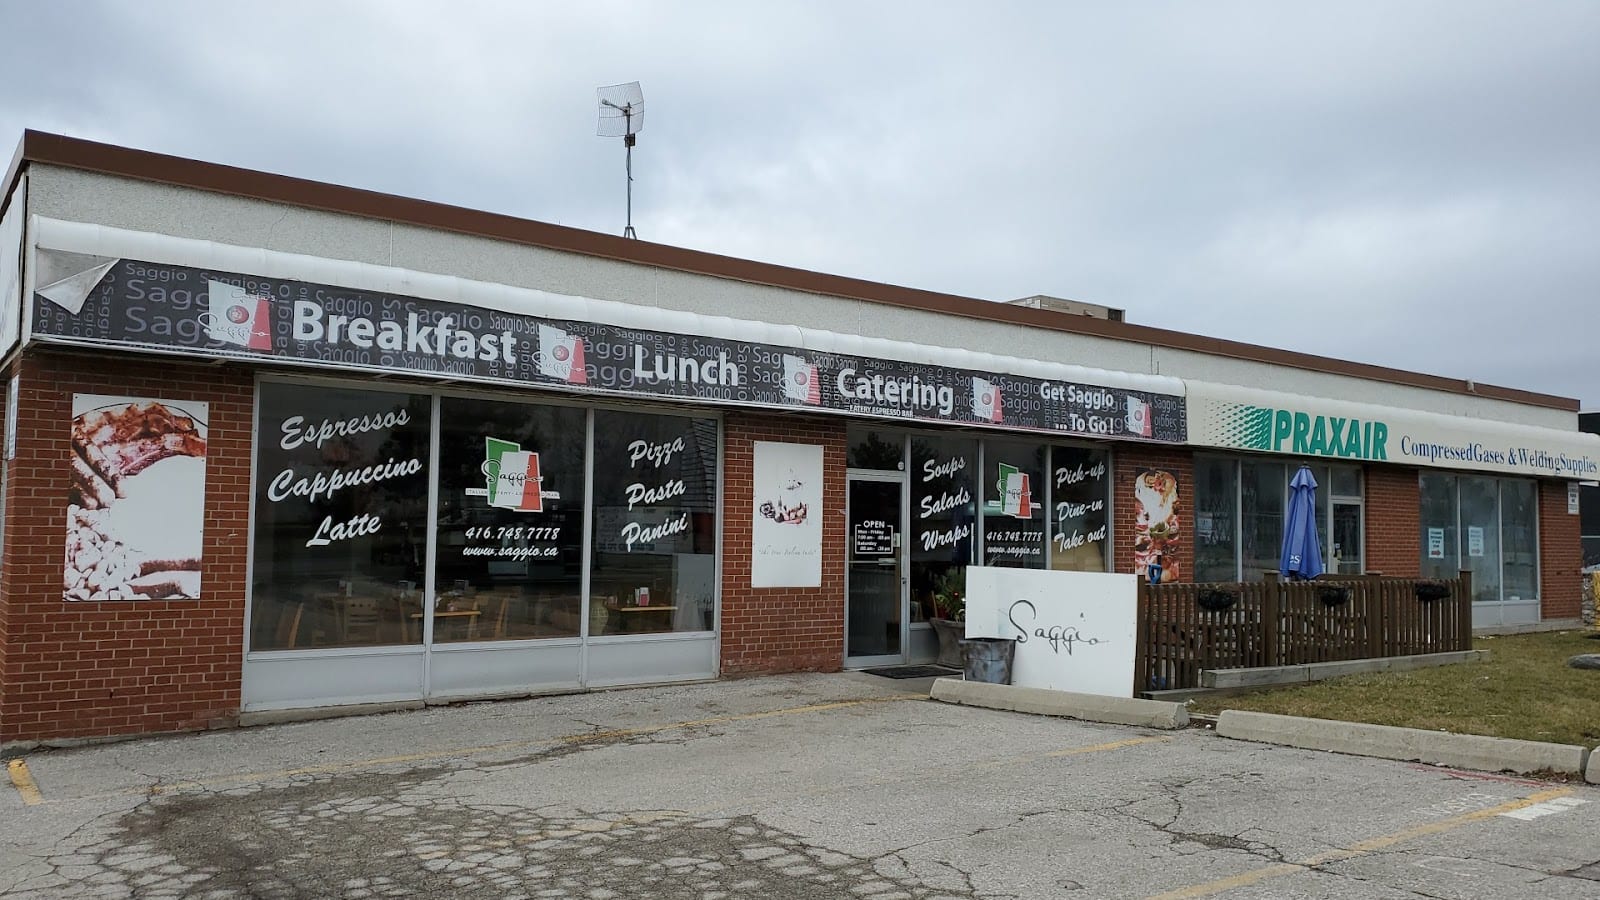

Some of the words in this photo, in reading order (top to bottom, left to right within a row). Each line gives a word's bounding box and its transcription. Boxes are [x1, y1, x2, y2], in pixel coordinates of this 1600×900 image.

[126, 262, 187, 282] Saggio
[125, 279, 209, 314] Sagg
[315, 289, 374, 320] Saggio
[97, 285, 114, 339] Saggi
[489, 311, 523, 333] Saggio
[292, 300, 517, 364] Breakfast
[565, 321, 608, 337] Saggio
[613, 327, 655, 342] Saggio
[312, 341, 371, 364] Saggio
[519, 340, 534, 380] aggio
[584, 341, 650, 361] aggio
[692, 339, 732, 361] Saggio
[634, 344, 739, 387] Lunch
[737, 344, 750, 400] Saggio
[863, 358, 894, 371] Saggio
[898, 362, 927, 375] Saggio
[691, 381, 732, 400] Saggio
[838, 368, 953, 416] Catering
[1000, 376, 1040, 397] Saggio
[1040, 381, 1066, 402] Get
[1067, 385, 1115, 410] Saggio
[850, 404, 872, 414] EATERY
[872, 406, 901, 417] ESPRESSO
[901, 409, 914, 418] BAR
[1001, 393, 1041, 414] Saggio
[1153, 396, 1177, 413] Saggio
[280, 408, 411, 450] Espressos
[1069, 413, 1086, 432] To
[1273, 409, 1388, 461] PRAXAIR
[628, 437, 685, 468] Pizza
[267, 457, 423, 503] Cappuccino
[481, 459, 544, 487] Saggio
[923, 457, 966, 482] Soups
[1055, 462, 1106, 489] Pick-up
[625, 479, 687, 511] Pasta
[920, 486, 970, 519] Salads
[1056, 499, 1104, 522] Dine-in
[305, 513, 381, 547] Latte
[465, 526, 560, 540] 416.748.7778
[621, 513, 688, 552] Panini
[863, 520, 885, 528] OPEN
[986, 531, 1043, 542] 416.748.7778
[921, 525, 969, 551] Wraps
[1054, 529, 1085, 553] Take
[1087, 524, 1106, 542] out
[463, 545, 559, 561] www.saggio.ca
[987, 546, 1041, 558] www.saggio.ca
[1008, 599, 1111, 656] Saggio
